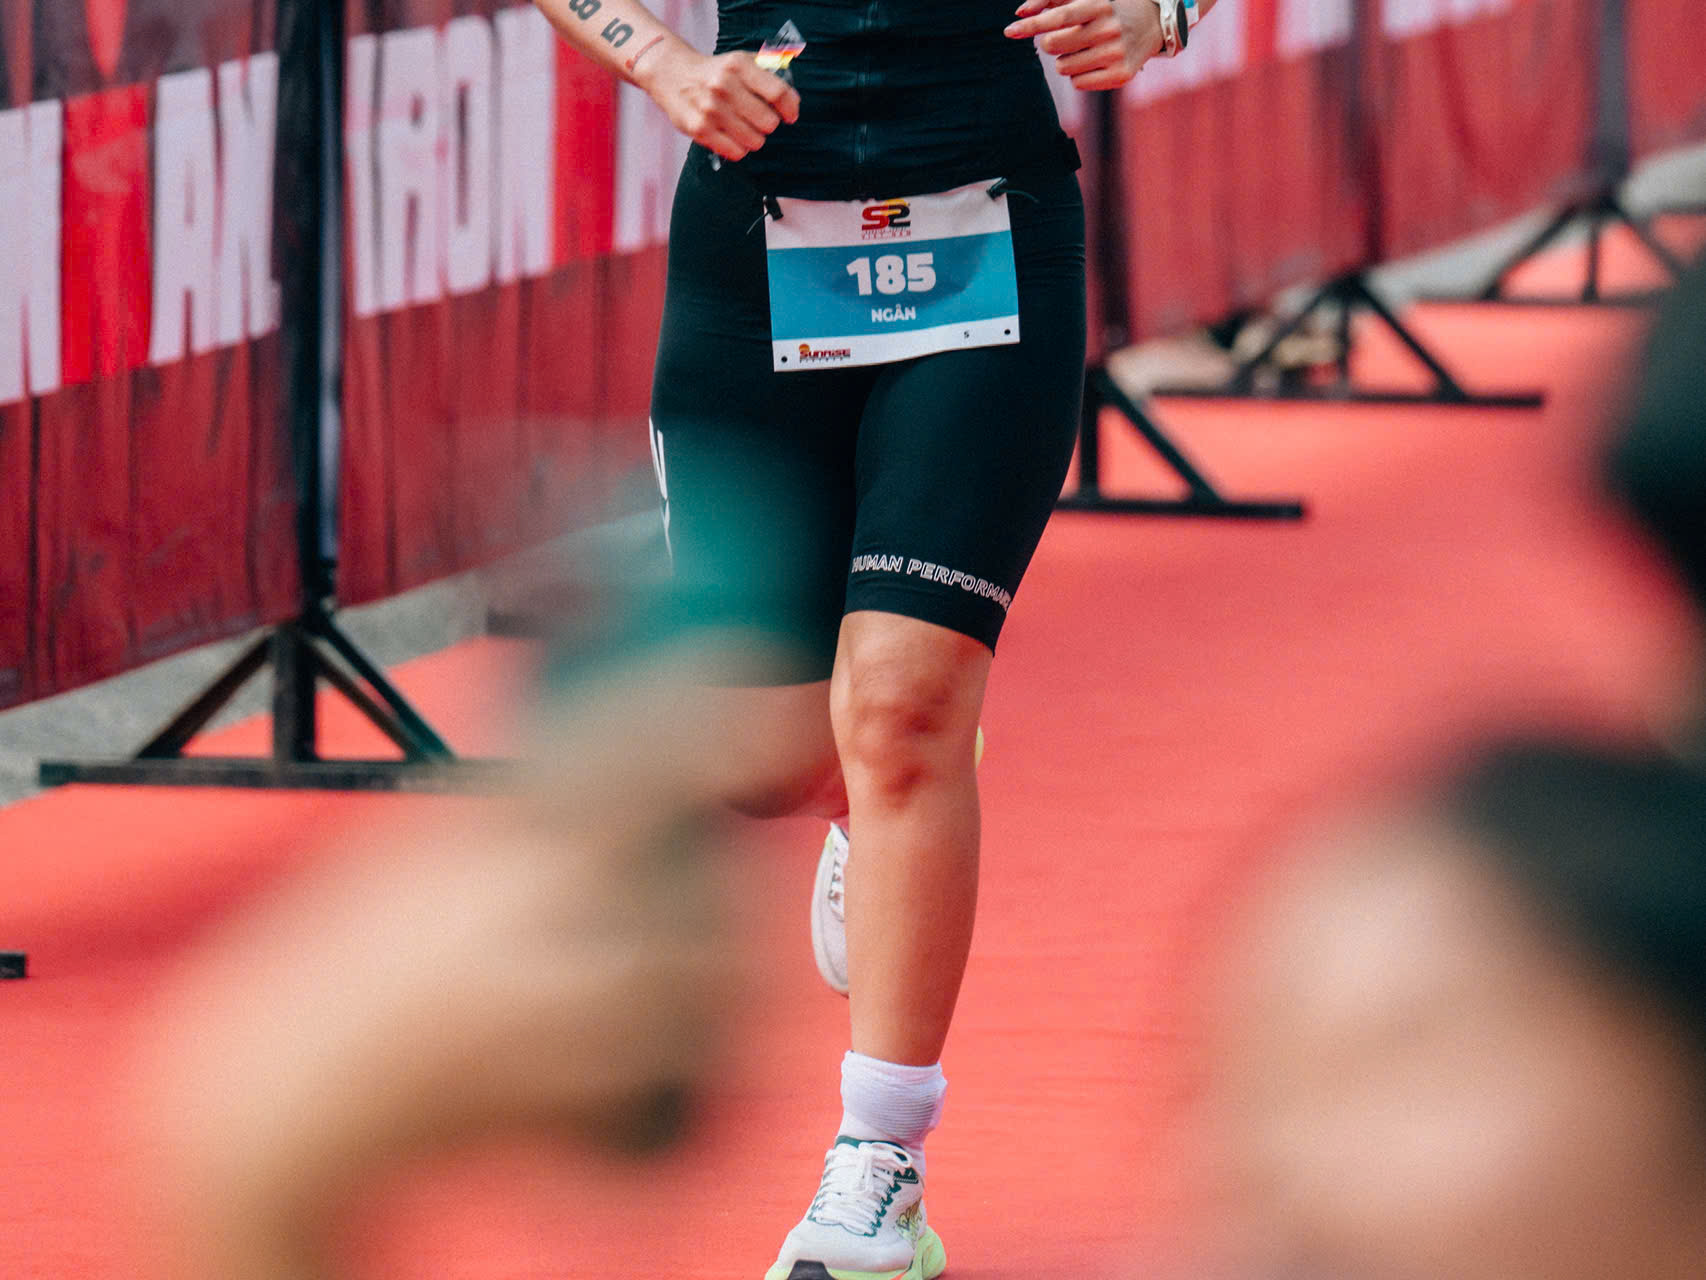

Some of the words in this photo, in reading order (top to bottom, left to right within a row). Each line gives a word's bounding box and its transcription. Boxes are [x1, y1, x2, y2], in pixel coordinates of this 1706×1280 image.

[846, 252, 936, 296] 185
[871, 304, 916, 323] NGÂN
[852, 554, 904, 574] HUMAN
